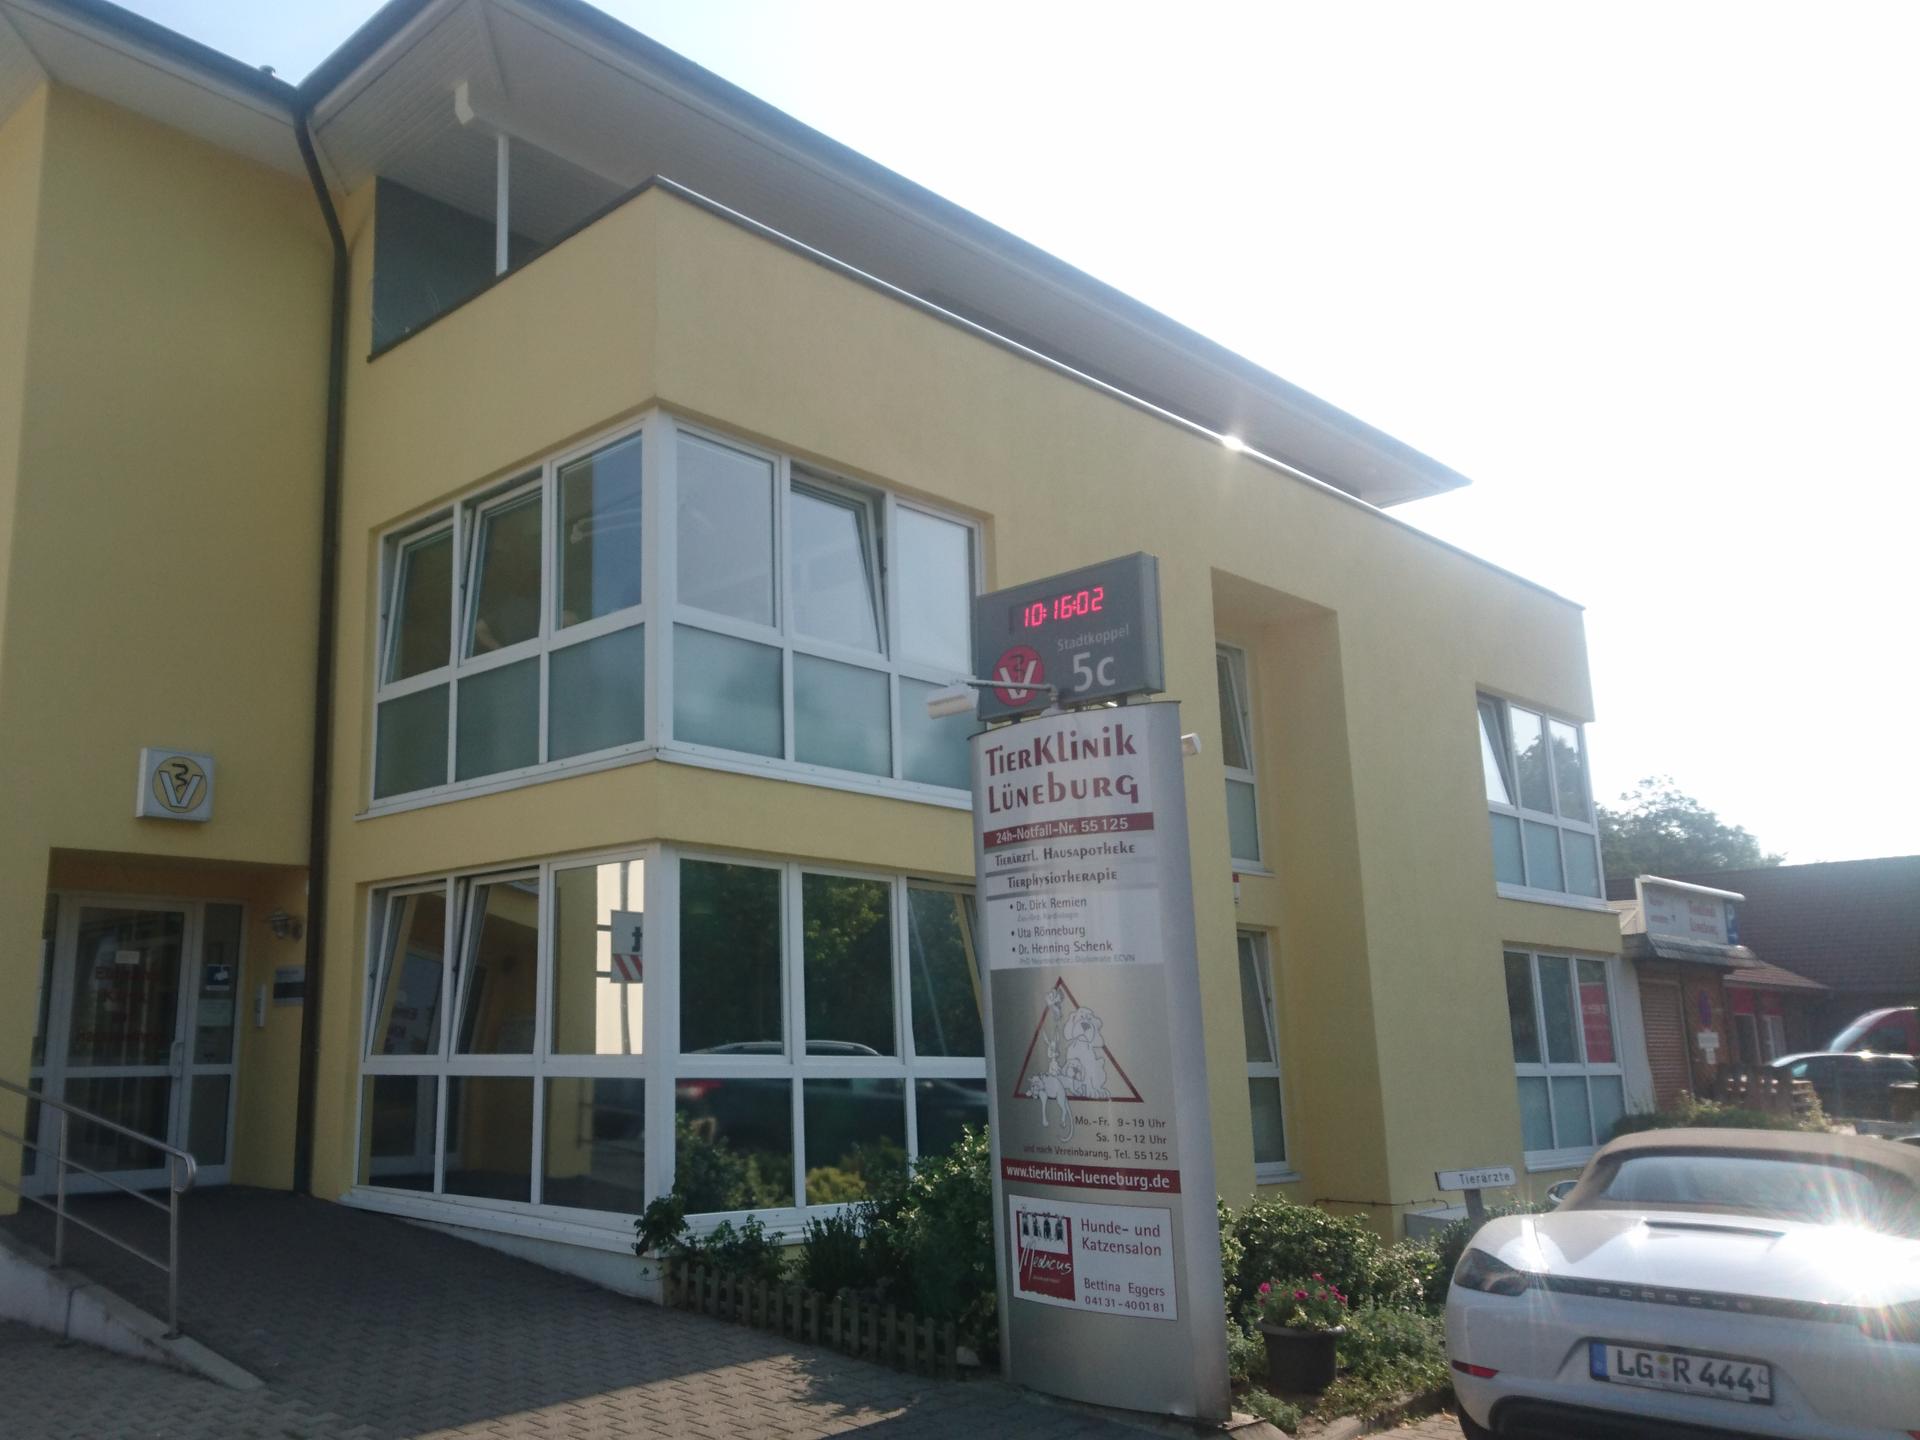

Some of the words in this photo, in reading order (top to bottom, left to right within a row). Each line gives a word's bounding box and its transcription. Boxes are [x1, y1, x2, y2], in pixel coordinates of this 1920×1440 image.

[1024, 586, 1104, 627] 10:16:02
[1057, 624, 1129, 651] Stadtkoppel
[1016, 901, 1028, 912] Dr.
[1029, 899, 1047, 911] Dirk
[1050, 897, 1087, 909] Remien
[1017, 927, 1031, 938] Uta
[1034, 925, 1086, 938] Rönneburg
[1018, 944, 1029, 955] Dr.
[1031, 942, 1070, 955] Henning
[1073, 940, 1113, 952] Schenk
[1148, 1118, 1167, 1129] Uhr
[1096, 1133, 1110, 1143] Sa.
[1149, 1134, 1167, 1145] Uhr
[1115, 1149, 1131, 1159] Tel.
[1006, 1165, 1170, 1191] www.tierklinik-lueneburg.de
[1080, 1218, 1129, 1236] Hunde-
[1134, 1224, 1161, 1238] und
[1081, 1237, 1162, 1256] Katzensalon
[1084, 1277, 1121, 1293] Bettina
[1128, 1282, 1166, 1298] Eggers
